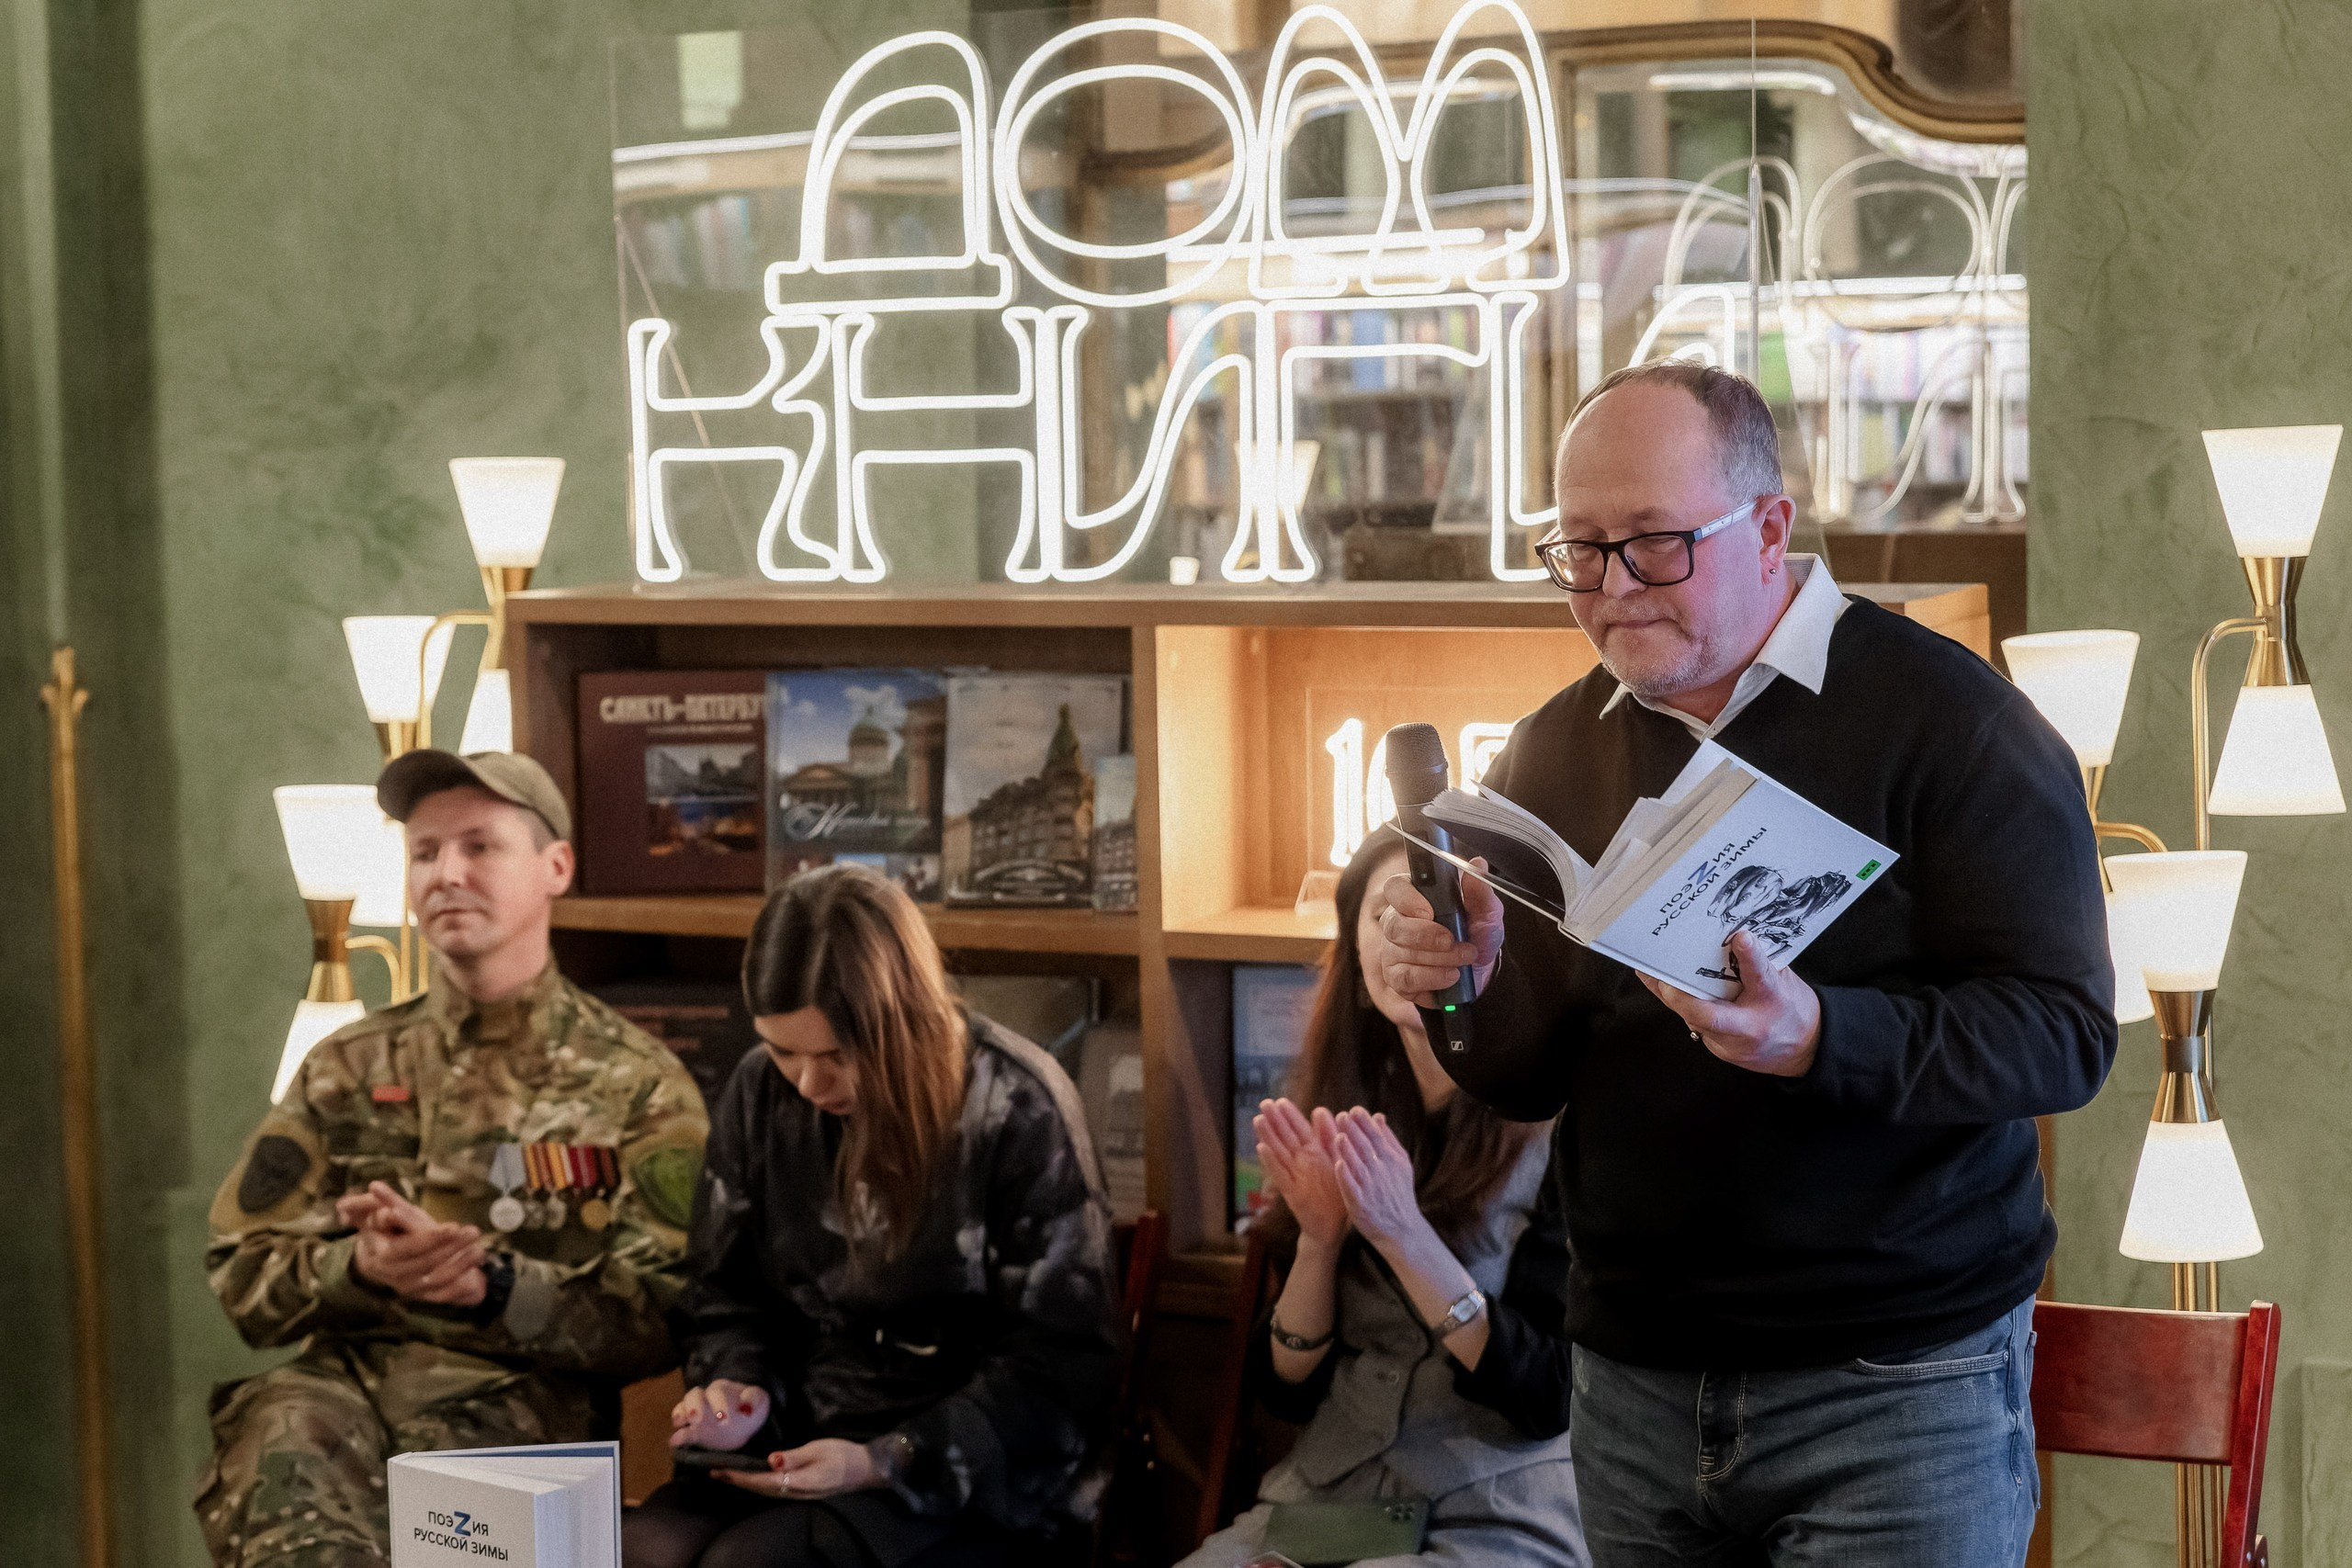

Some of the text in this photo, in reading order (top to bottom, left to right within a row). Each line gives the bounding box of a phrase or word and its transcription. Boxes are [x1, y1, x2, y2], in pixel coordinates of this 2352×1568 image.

[764, 0, 1571, 314] ДОМ
[1651, 827, 1768, 936] РУССКОЙ ЗИМЫ
[413, 1528, 508, 1562] РУССКОЙ ЗИМЫ
